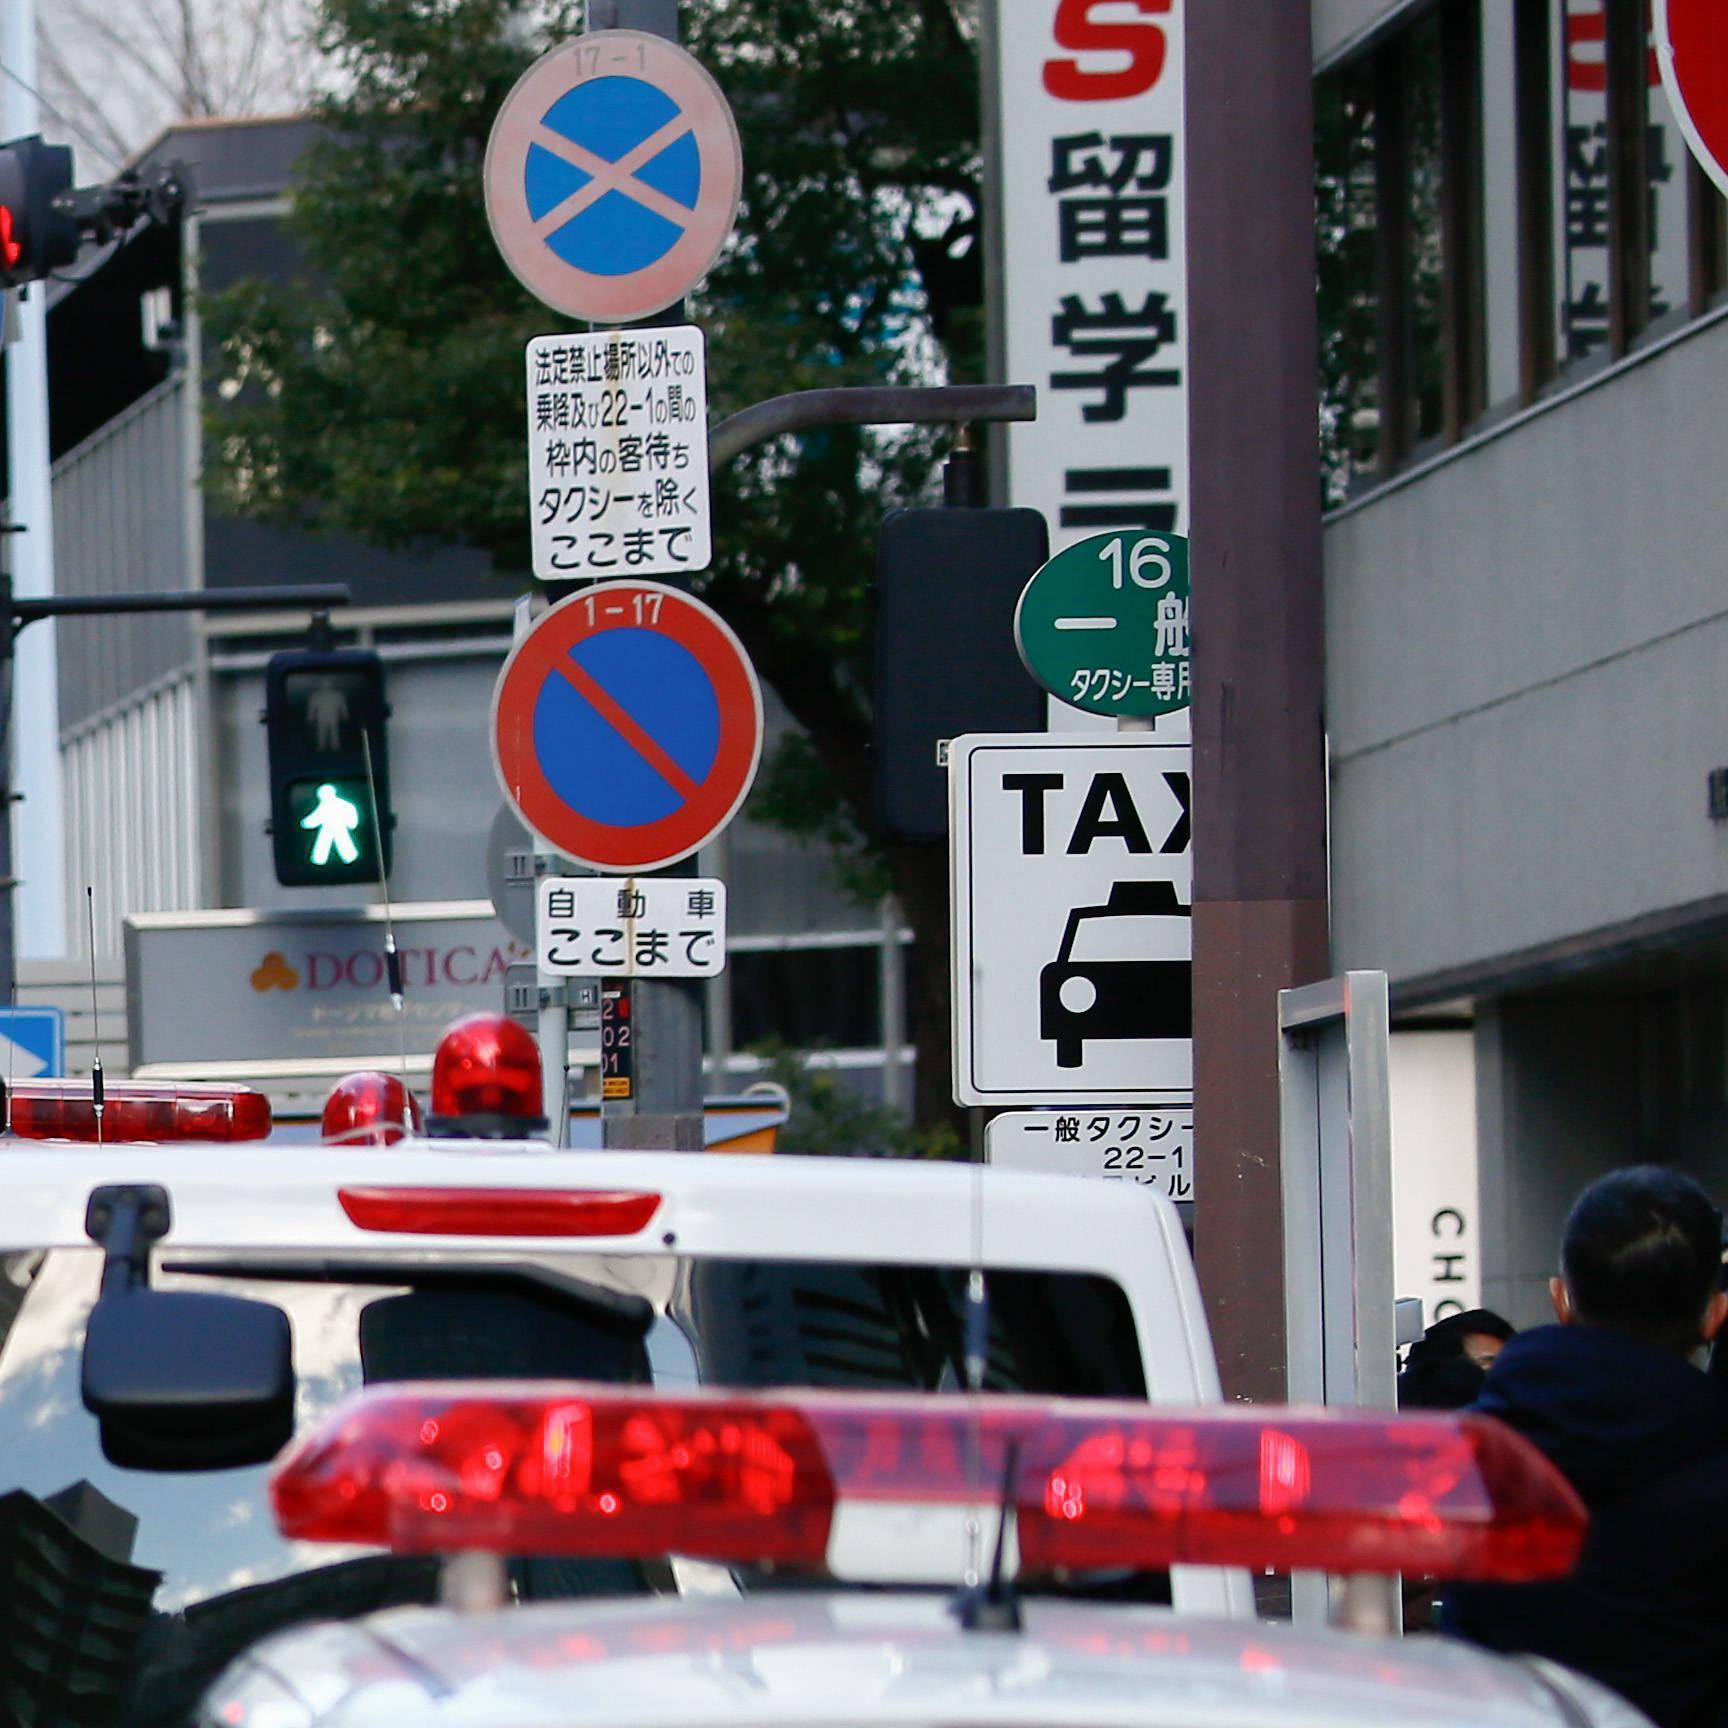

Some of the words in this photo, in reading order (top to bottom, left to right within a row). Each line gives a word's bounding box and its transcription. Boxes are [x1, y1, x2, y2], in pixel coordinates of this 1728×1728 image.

[535, 340, 694, 386] 法定禁止場所以外での
[545, 431, 690, 478] 枠内の客待ち
[539, 477, 698, 525] タクシーを除く
[550, 526, 693, 570] ここまで
[1098, 537, 1173, 590] 16
[585, 594, 664, 627] 1-17
[548, 889, 716, 920] 自動車
[547, 928, 716, 968] ここまで
